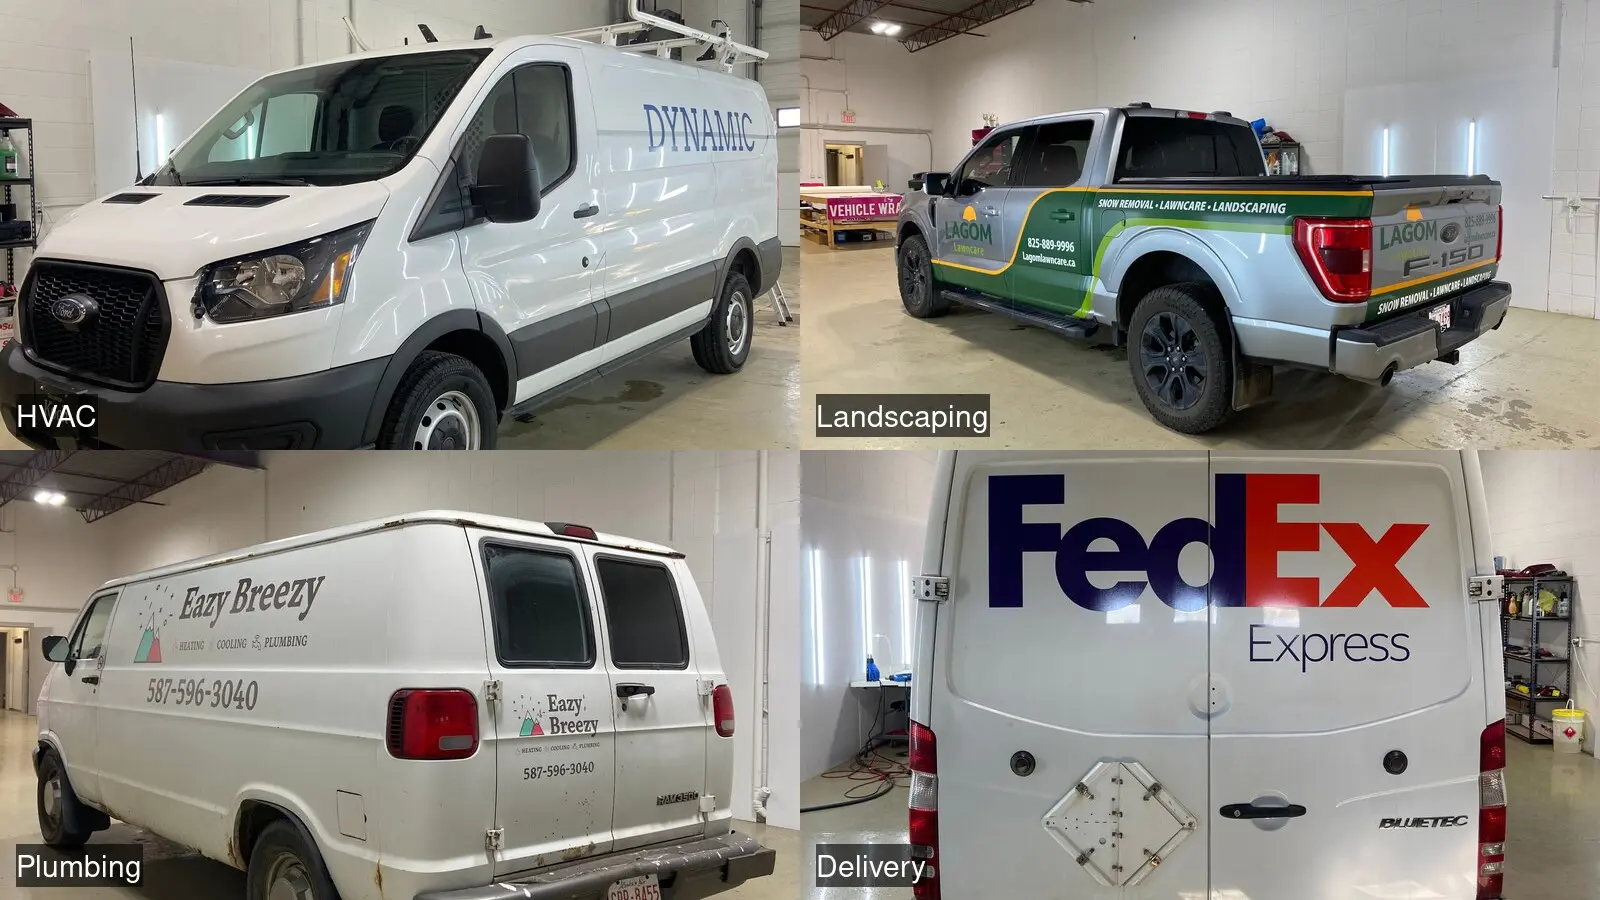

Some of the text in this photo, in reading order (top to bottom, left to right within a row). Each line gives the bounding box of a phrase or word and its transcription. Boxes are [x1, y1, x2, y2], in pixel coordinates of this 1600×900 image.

[643, 104, 755, 152] DYNAMIC
[829, 203, 876, 217] VEHICLE
[1098, 199, 1287, 214] SNOW REMOVAL LAWNCARE LANDSCAPING
[945, 221, 993, 245] LAGOM
[1380, 220, 1438, 250] LAGOM
[953, 242, 985, 256] Lawncare
[1027, 238, 1075, 252] 825-889-9996
[1022, 252, 1076, 267] Lagomlawncare.ca
[1403, 244, 1484, 277] F-150
[1377, 297, 1401, 315] SNOW
[1400, 291, 1429, 308] REMOVAL
[1432, 281, 1461, 297] LAWNCARE
[988, 473, 1430, 612] FedEx
[179, 576, 326, 628] Eazy Breezy
[179, 635, 308, 651] HEATING COOLING PLUMBING
[1249, 624, 1410, 673] Express
[147, 678, 259, 711] 587-596-3040
[547, 694, 582, 717] Eazy
[549, 716, 599, 737] Breezy
[523, 761, 595, 780] 587-596-3040
[1379, 815, 1468, 828] BLUETEC
